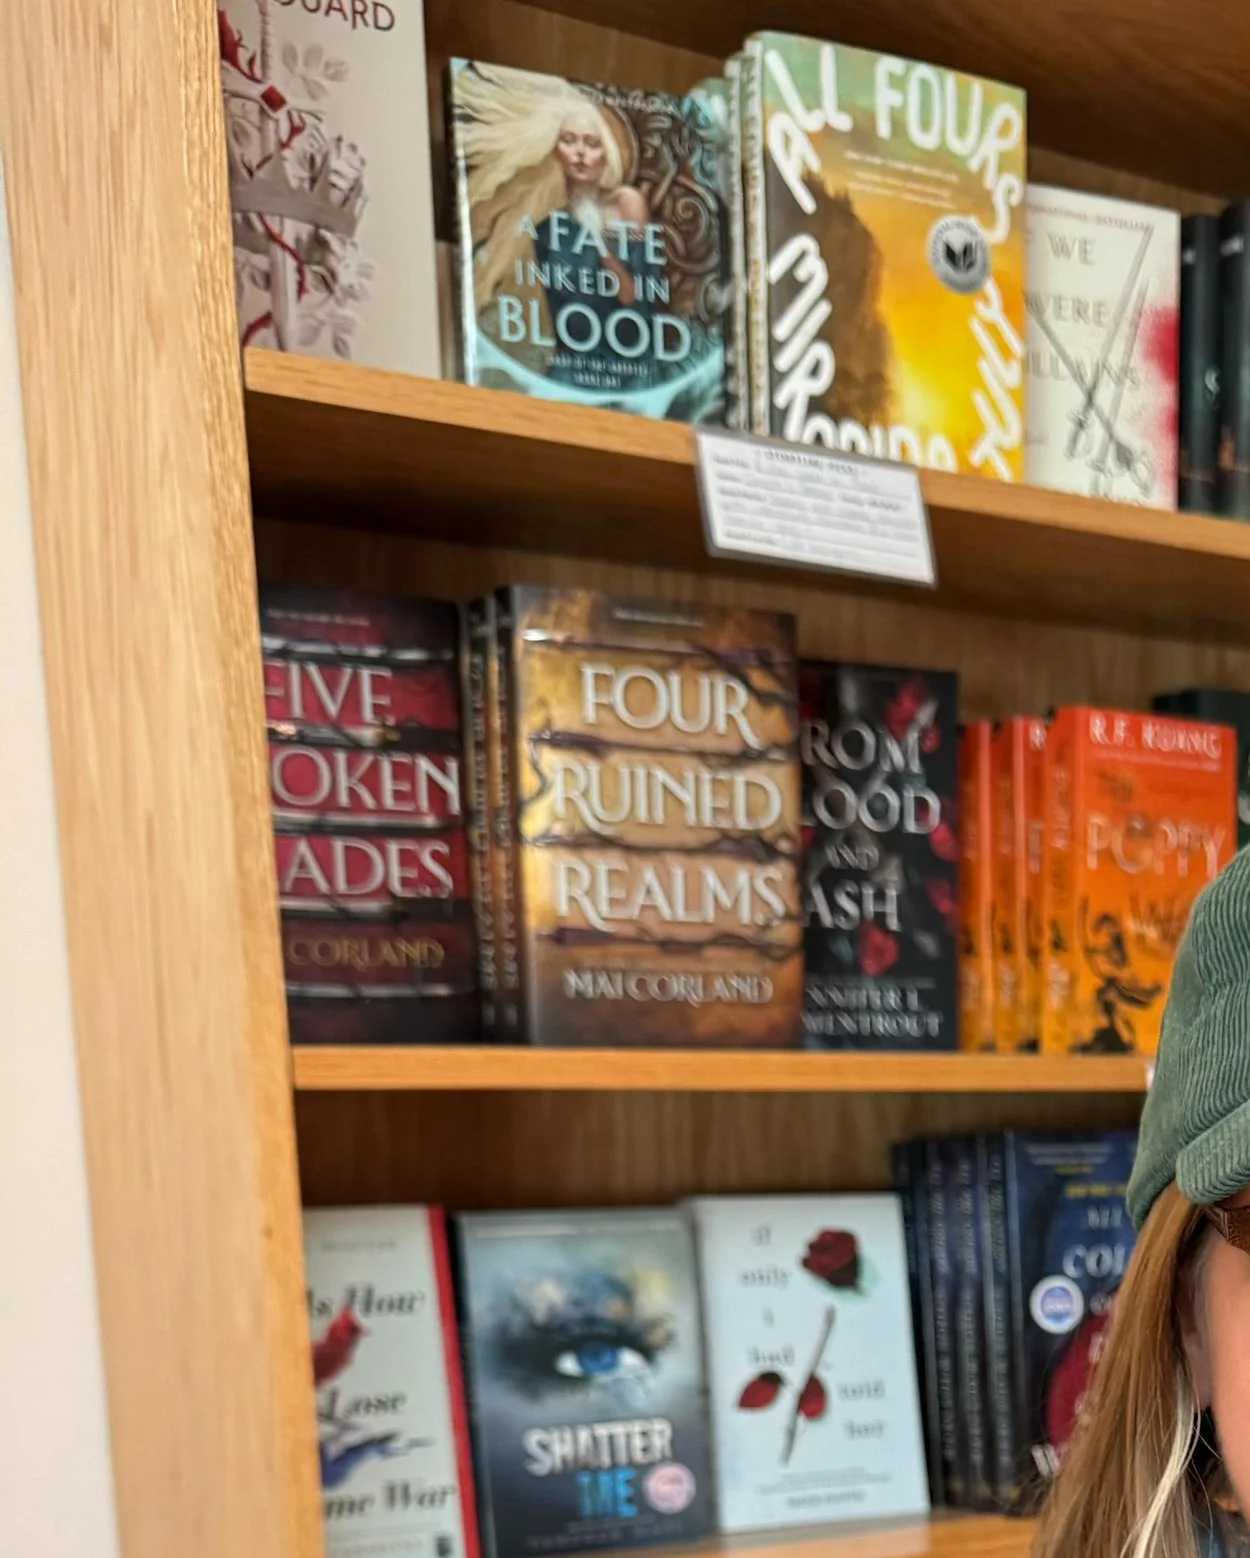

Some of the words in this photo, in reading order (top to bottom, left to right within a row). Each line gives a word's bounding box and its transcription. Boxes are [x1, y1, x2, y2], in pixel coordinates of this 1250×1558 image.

[872, 55, 1023, 244] FOURS
[516, 212, 539, 240] A
[549, 207, 668, 265] FATE
[1047, 232, 1097, 266] WE
[514, 259, 620, 298] INKED
[634, 276, 671, 303] IN
[497, 295, 692, 363] BLOOD
[579, 662, 764, 754] FOUR
[801, 717, 922, 773] ROM
[1140, 720, 1223, 760] KUANG
[271, 746, 462, 816] OKEN
[553, 760, 782, 836] RUINED
[802, 781, 942, 835] OOD
[284, 836, 454, 898] ADES
[1086, 811, 1228, 880] POPPY
[556, 856, 790, 933] REALMS
[802, 877, 901, 933] ASH
[289, 937, 446, 972] CORLAND
[624, 969, 774, 1007] CORLAND
[523, 1417, 675, 1478] SHATTER
